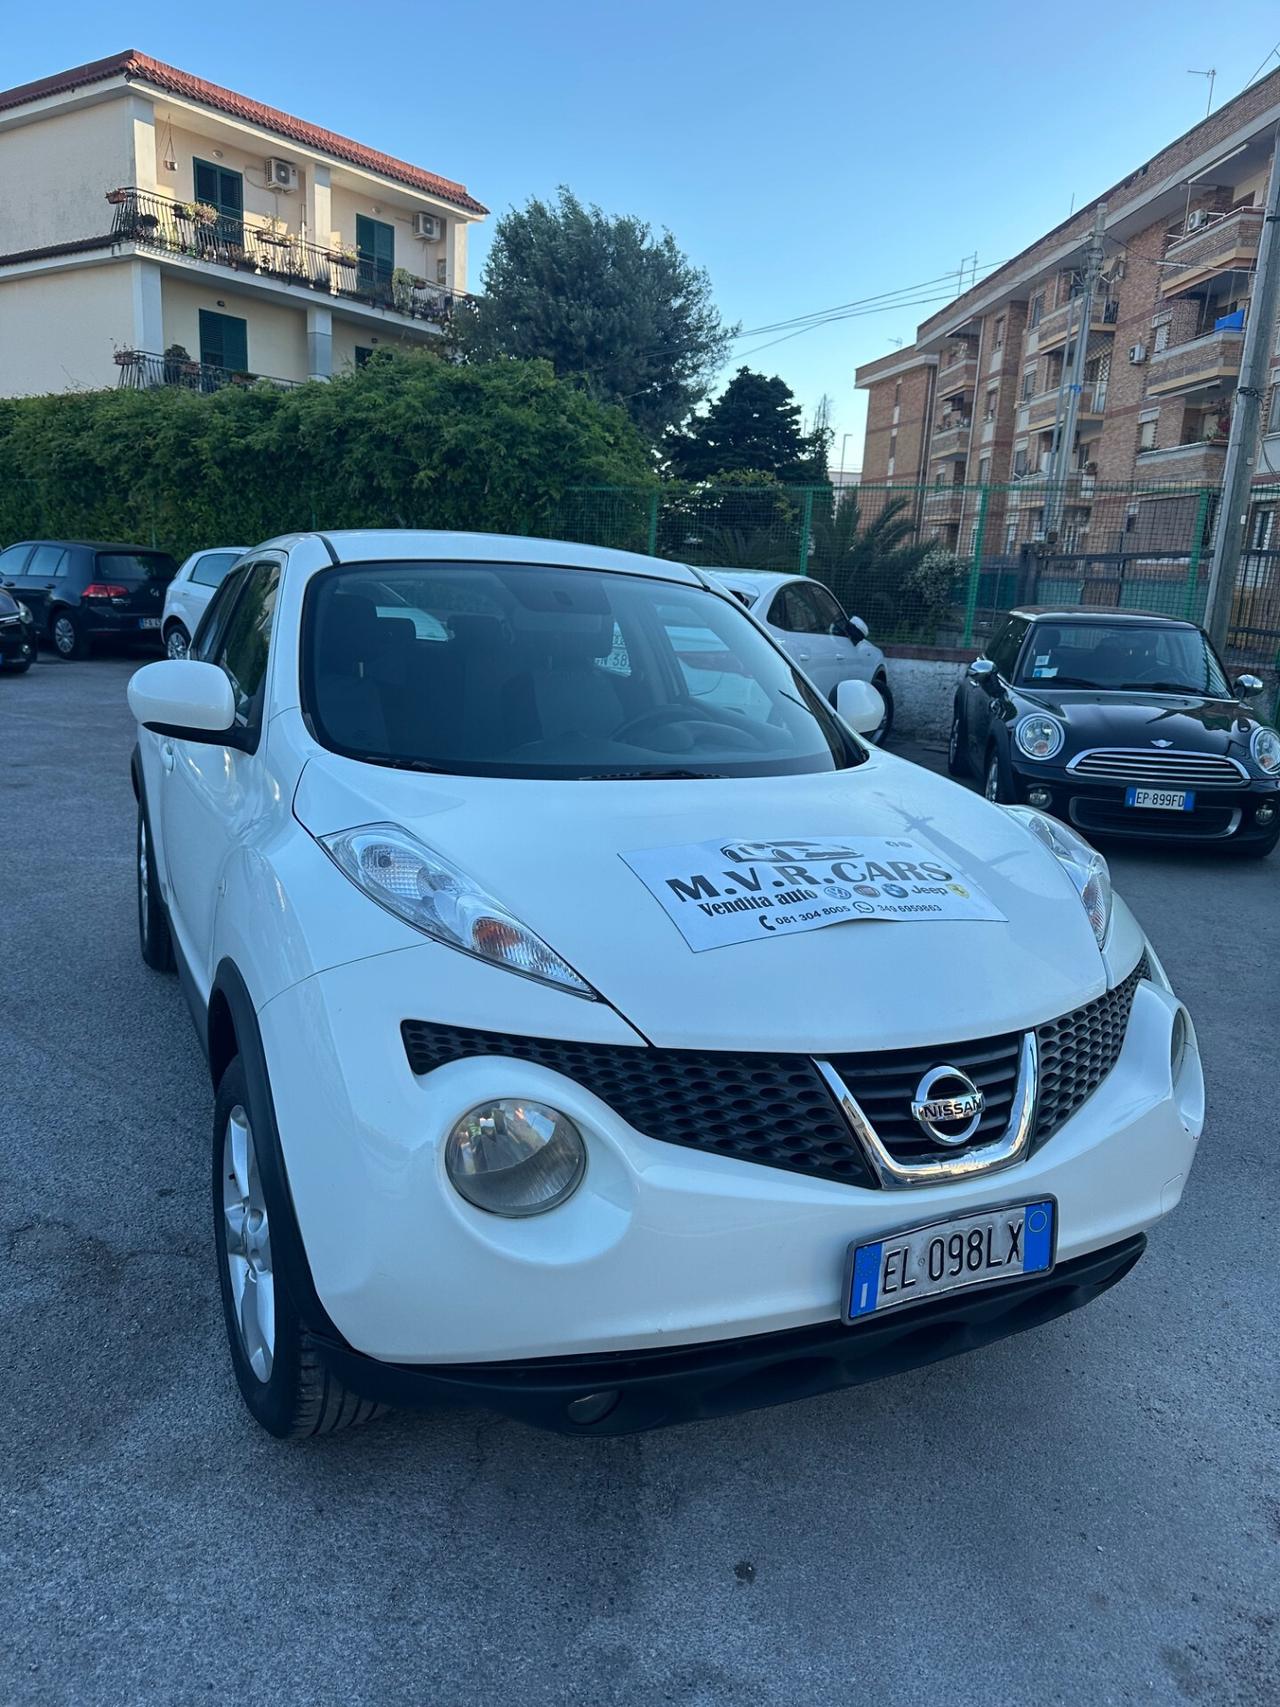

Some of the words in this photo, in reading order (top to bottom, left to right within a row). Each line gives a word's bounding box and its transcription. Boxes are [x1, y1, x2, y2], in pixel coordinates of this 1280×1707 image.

[665, 861, 952, 903] M.V.R.CARS
[911, 885, 948, 896] Jeep
[697, 895, 774, 917] Vendita
[774, 888, 818, 905] auto
[775, 915, 797, 925] 081
[798, 910, 822, 921] 304
[822, 905, 851, 915] 8005
[923, 1098, 982, 1118] NISSAN
[882, 1246, 917, 1294] EL
[928, 1218, 1024, 1282] 098LX
